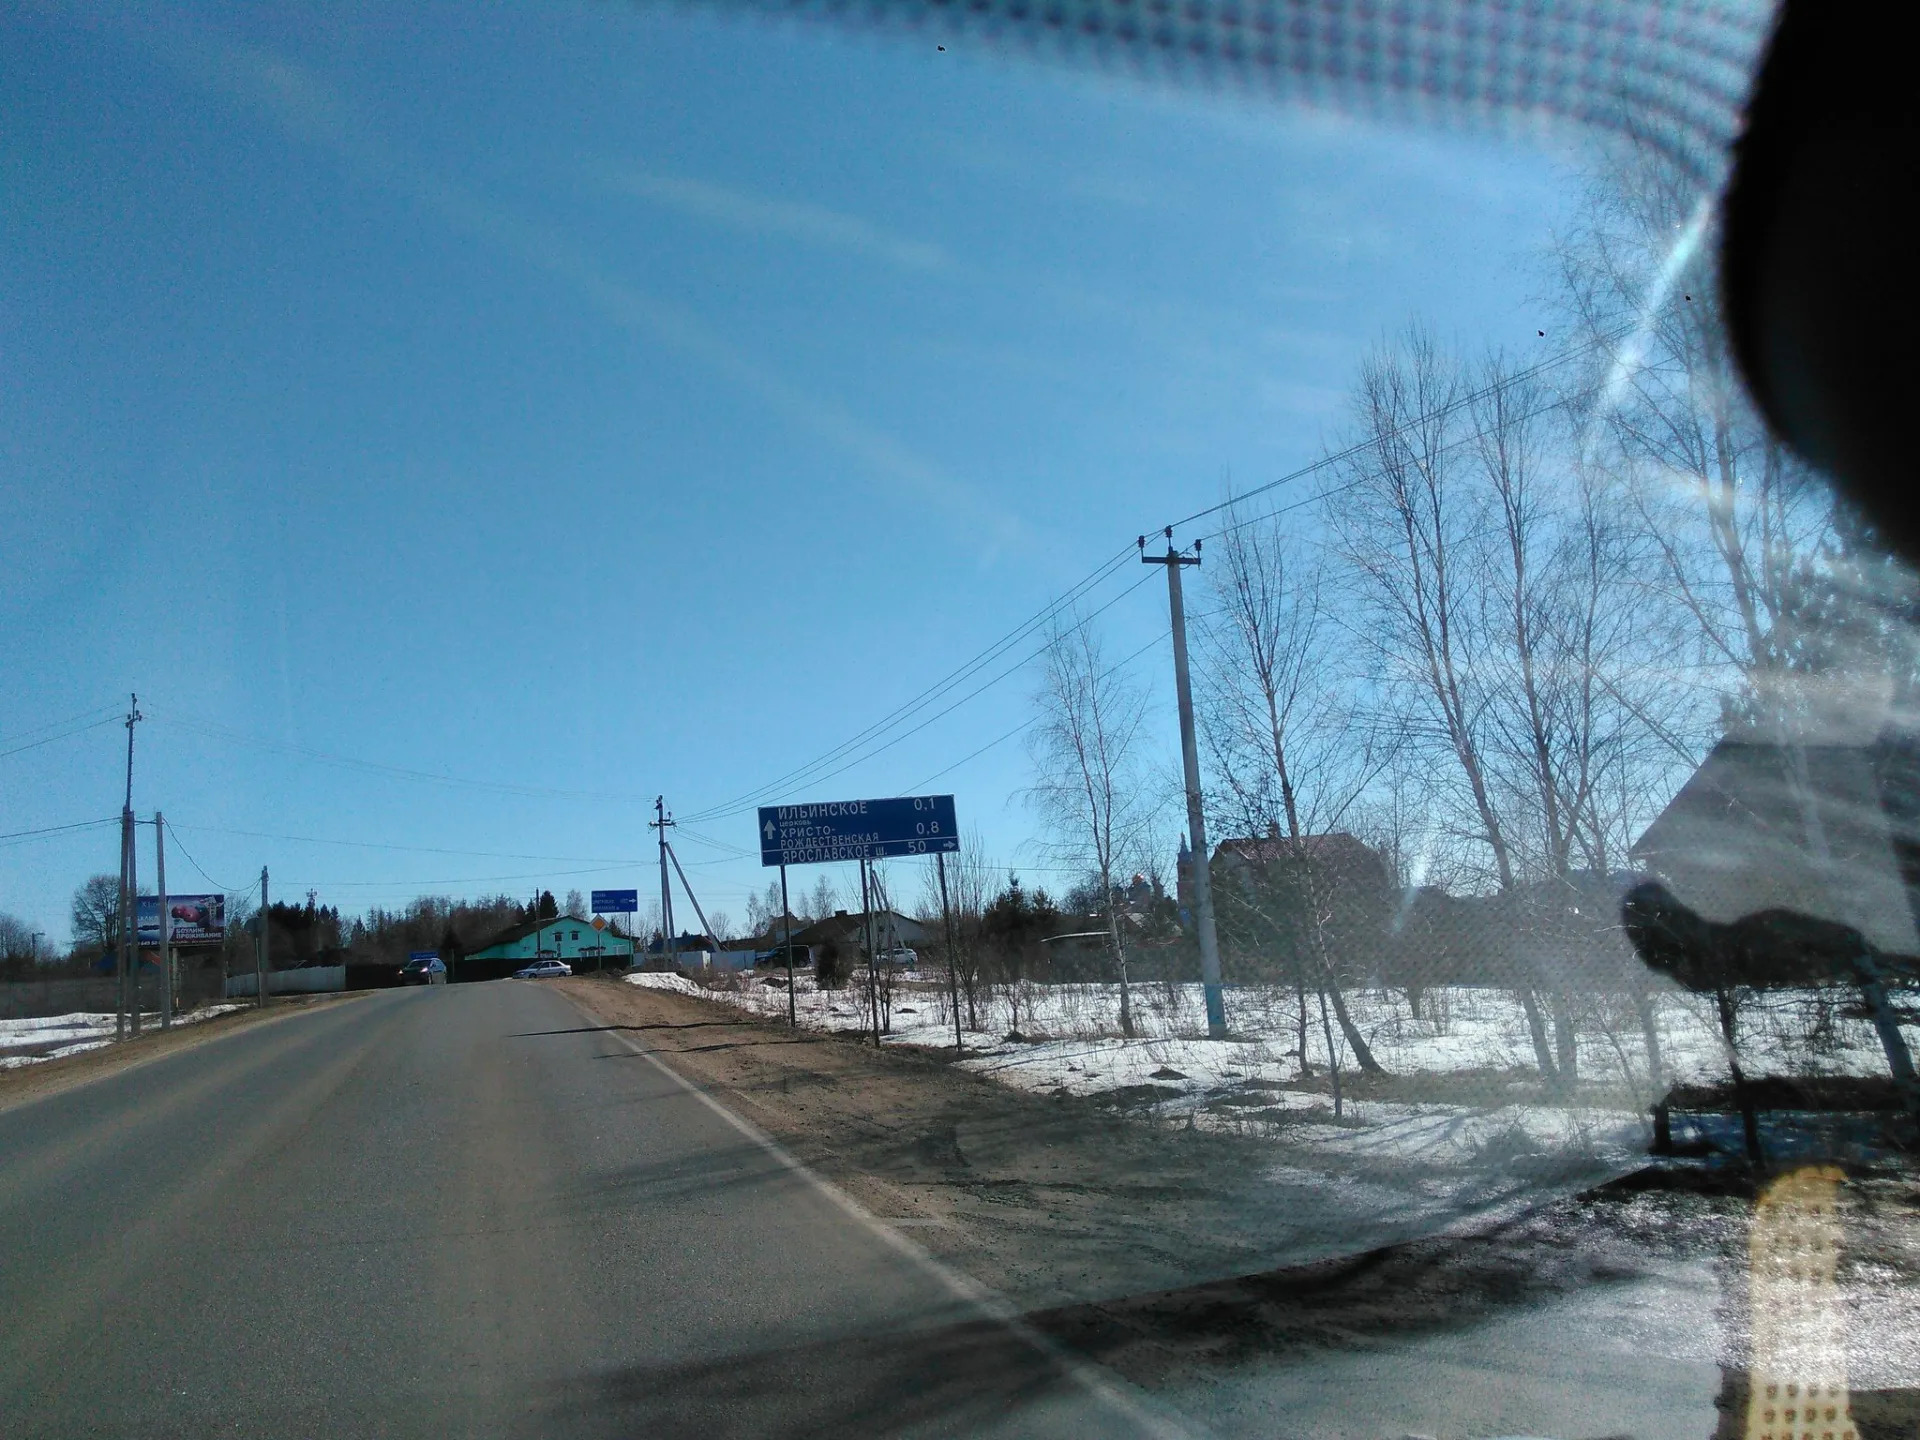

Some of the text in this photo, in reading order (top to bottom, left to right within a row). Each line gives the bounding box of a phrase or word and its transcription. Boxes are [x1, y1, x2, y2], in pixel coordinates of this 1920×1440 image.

[778, 801, 868, 820] ИЛЬИНСКОЕ
[779, 819, 812, 827] церковь
[780, 825, 836, 839] ХРИСТО-
[780, 832, 880, 849] РОЖДЕСТВЕНСКАЯ
[782, 844, 870, 864] ЯРОСЛАВСКОЕ
[908, 840, 926, 854] 50
